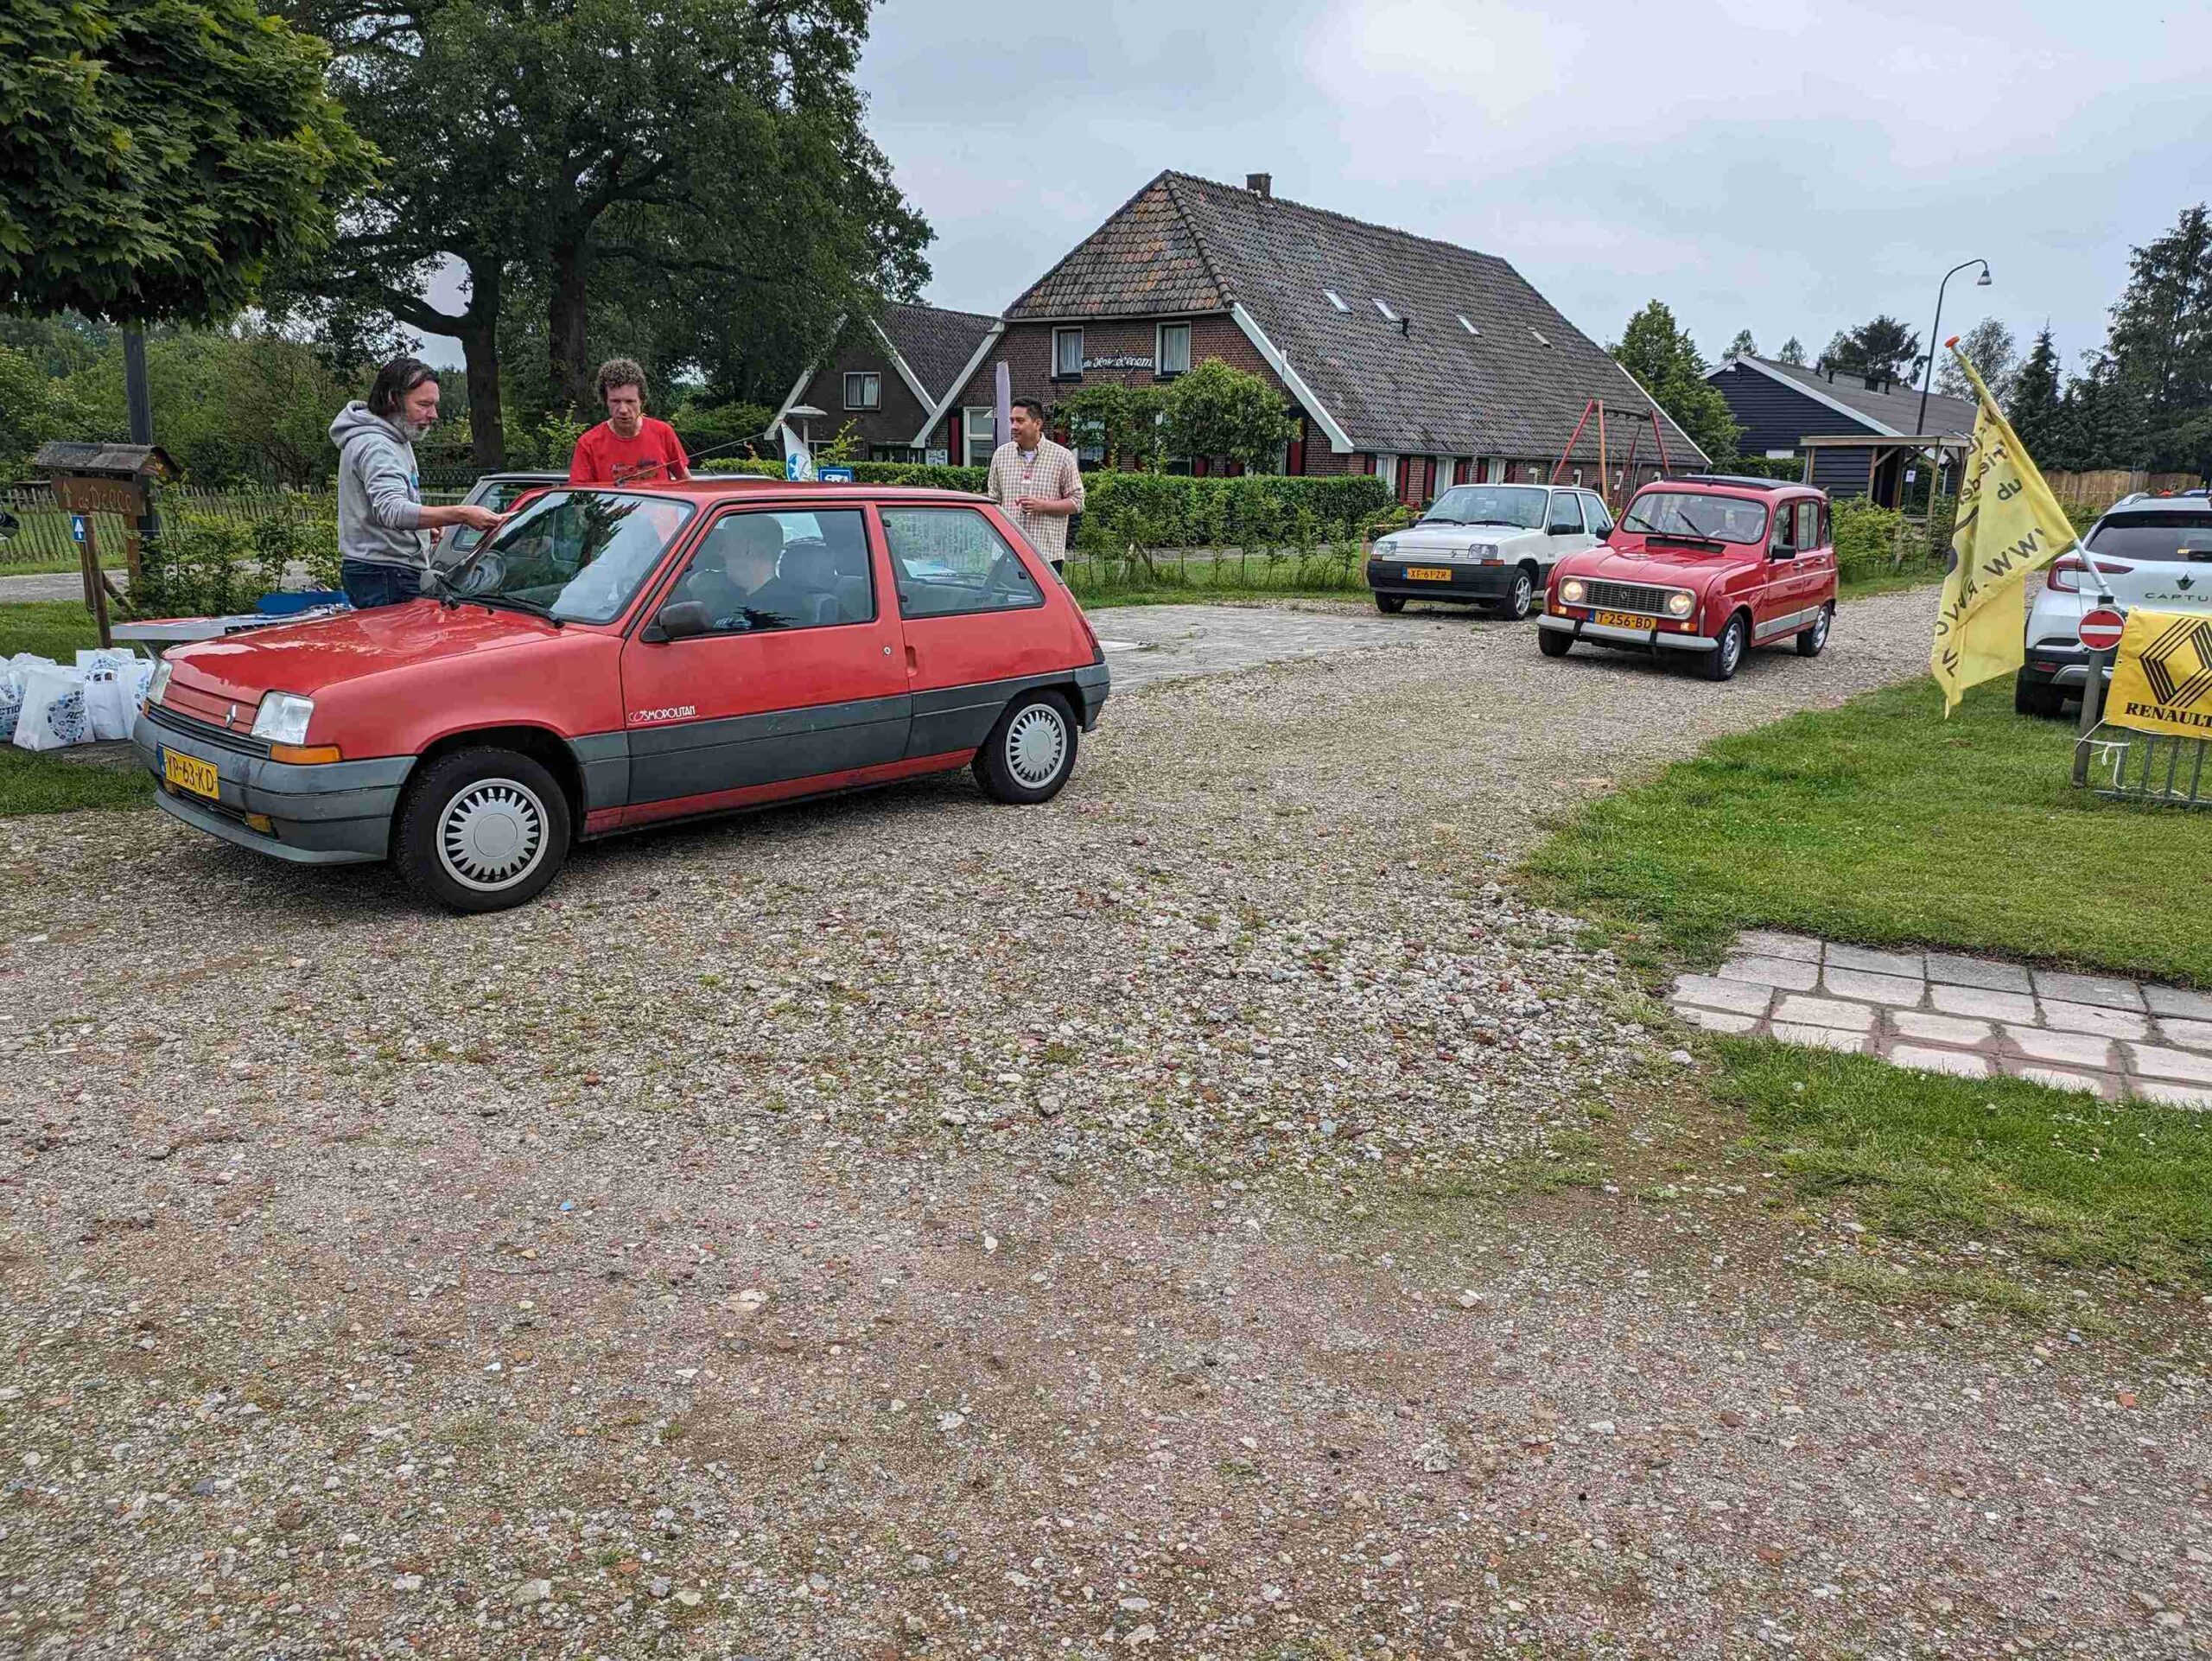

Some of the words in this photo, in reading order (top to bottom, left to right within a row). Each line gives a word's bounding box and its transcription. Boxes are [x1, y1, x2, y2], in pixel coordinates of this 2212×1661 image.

[1599, 611, 1652, 629] T-256-BD
[628, 705, 696, 722] COSMOPOLITAN
[2124, 702, 2212, 729] RENAULT
[168, 754, 214, 792] YP-63-KD
